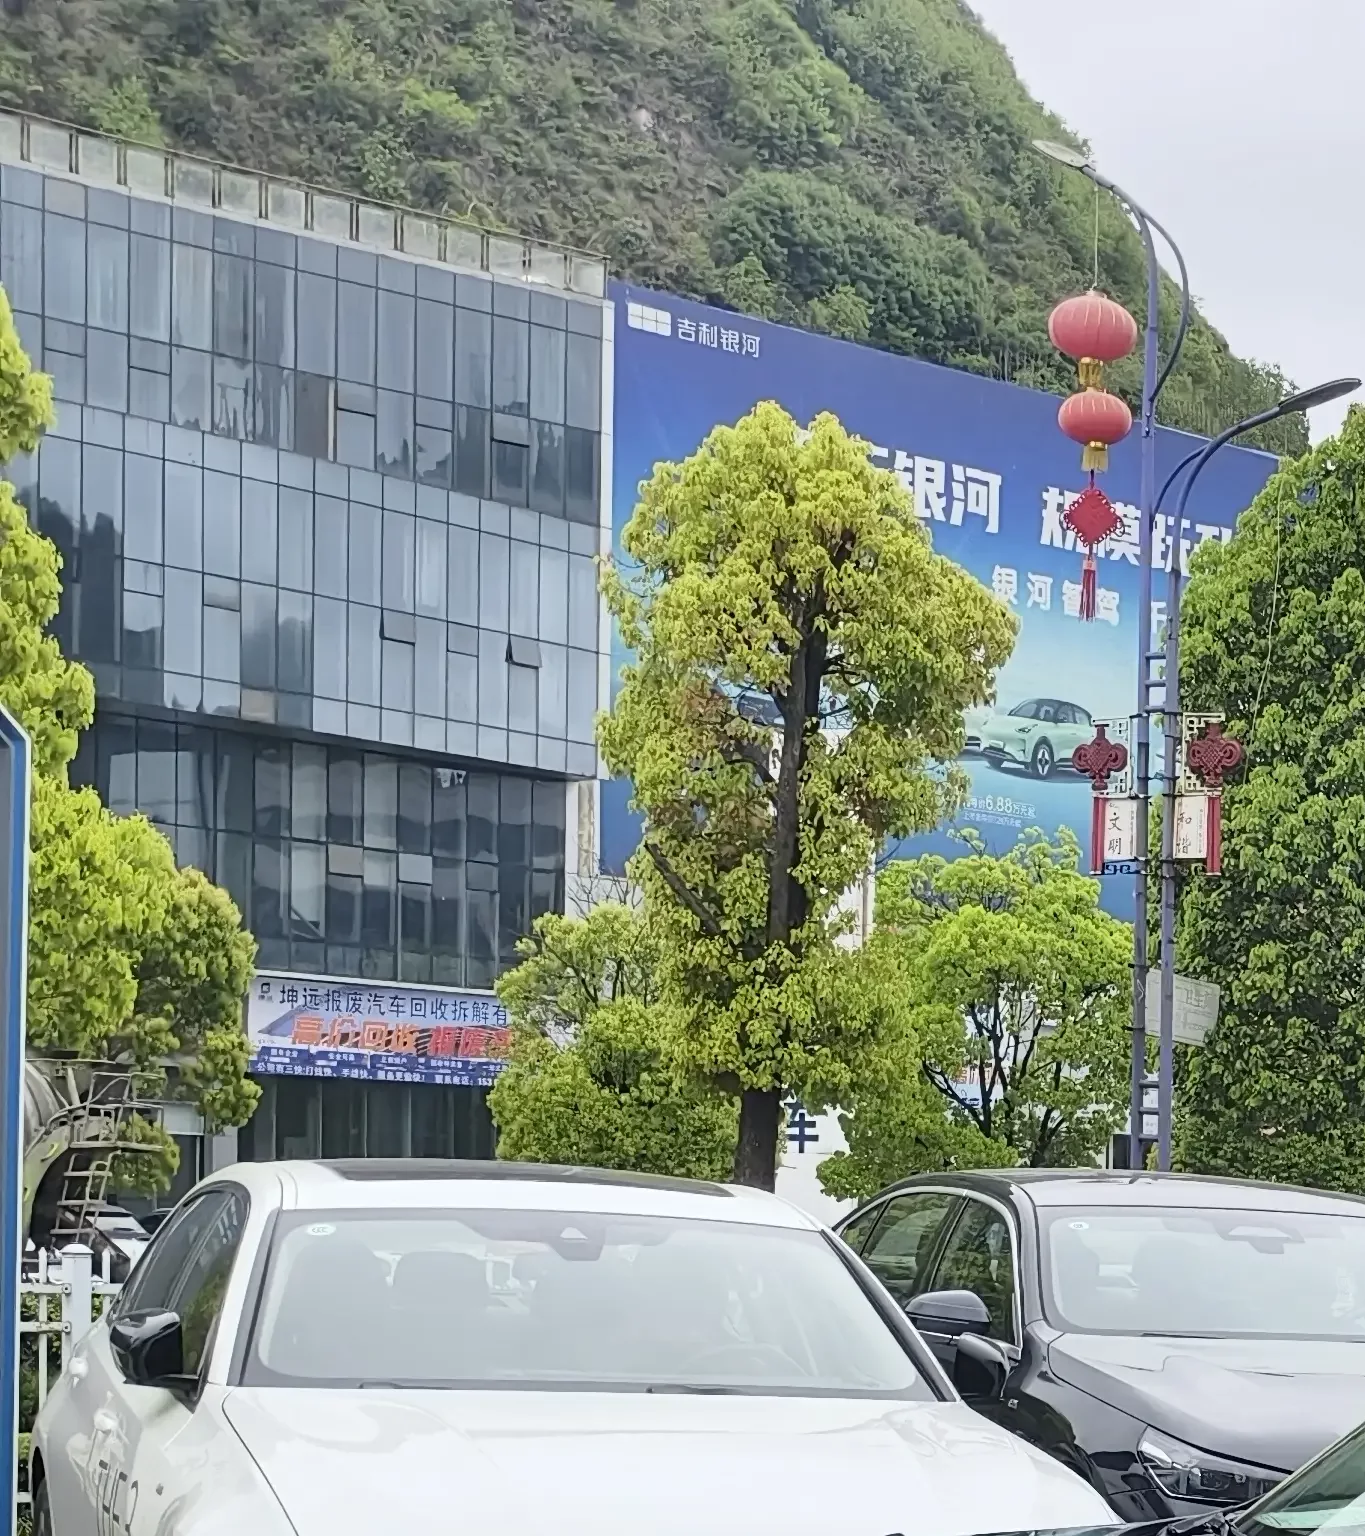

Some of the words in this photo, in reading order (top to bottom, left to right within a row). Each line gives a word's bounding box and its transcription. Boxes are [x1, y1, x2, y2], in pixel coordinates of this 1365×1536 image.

[677, 317, 761, 358] 吉利银河
[868, 441, 1002, 534] 银河
[279, 984, 507, 1027] 坤远报废汽车回收拆解有
